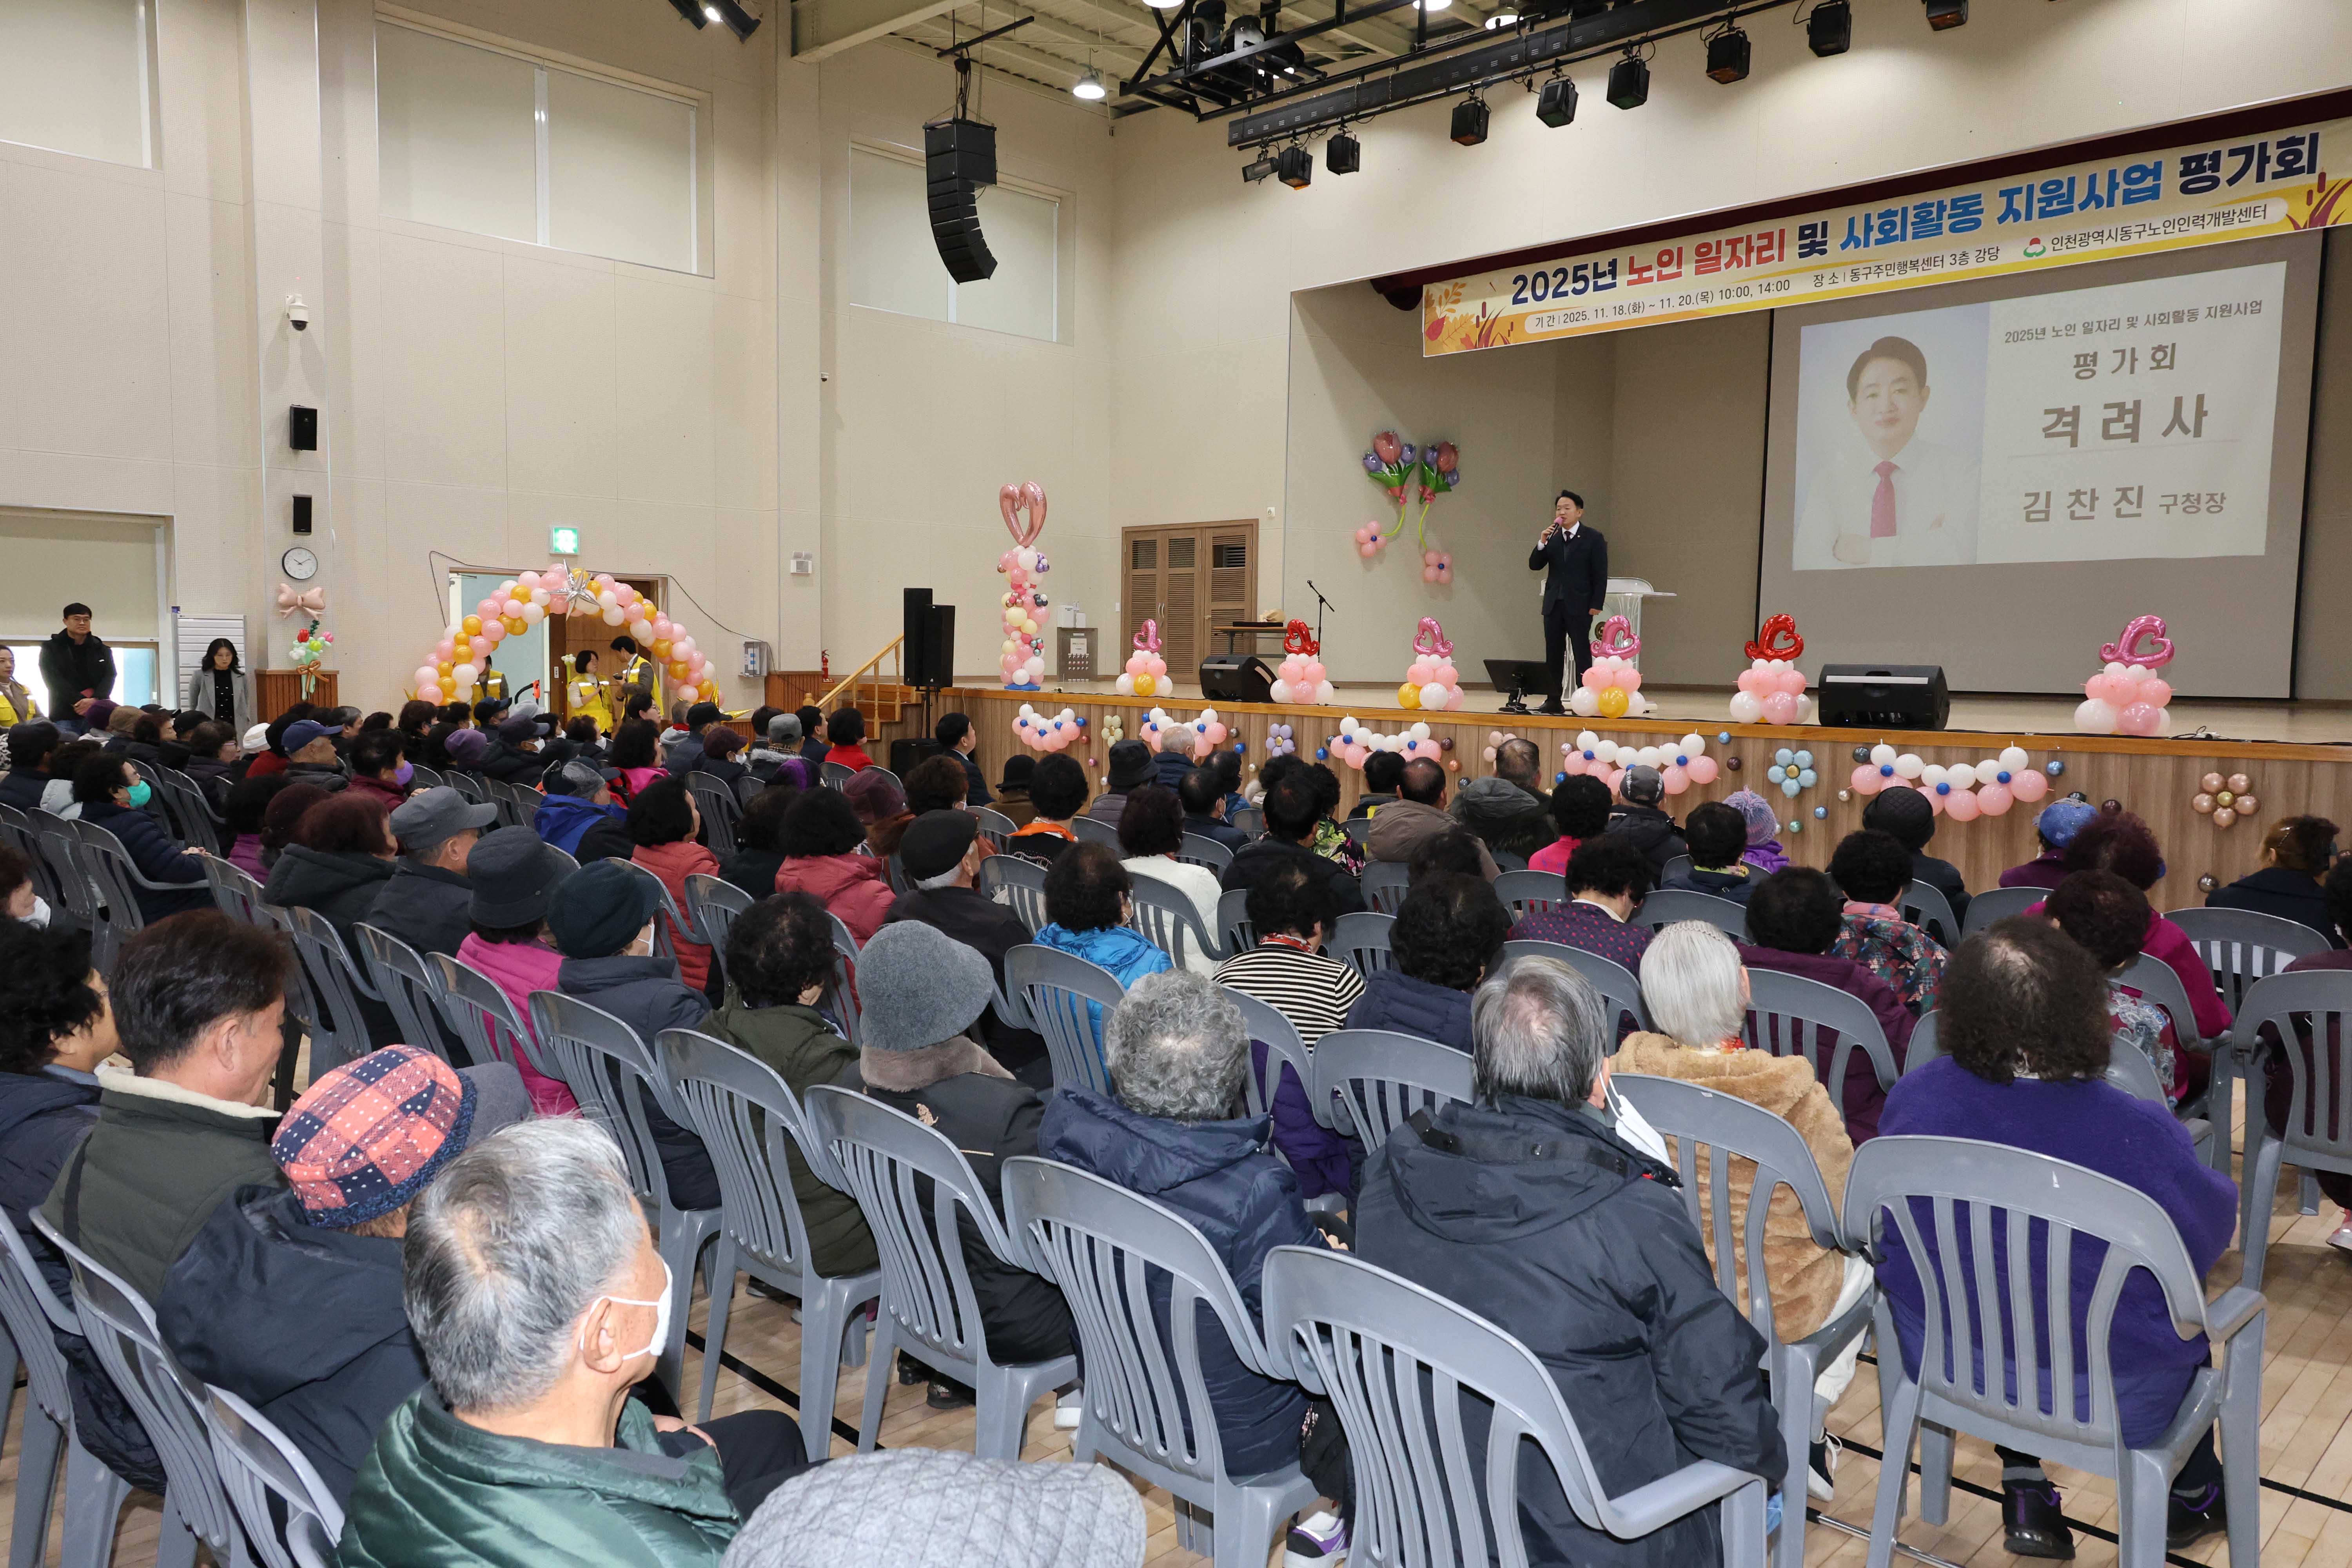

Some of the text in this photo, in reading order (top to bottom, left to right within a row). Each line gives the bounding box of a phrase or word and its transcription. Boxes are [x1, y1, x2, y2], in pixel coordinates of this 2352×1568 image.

[1511, 132, 2320, 306] 2025년 노인 일자리 및 사회활동 지원사업 평가회
[2051, 203, 2267, 251] 인천광역시동구노인인력개발센터
[1850, 254, 1944, 282] 동구주민행복센터
[1949, 251, 1970, 266] 3층
[1975, 246, 2000, 263] 강당
[1563, 310, 1590, 323] 2025.
[1594, 308, 1608, 319] 11.
[1613, 301, 1645, 316] 18.(화)
[1660, 298, 1674, 309] 11.
[1679, 290, 1714, 306] 20.(목)
[1719, 285, 1753, 300] 10:00,
[1758, 279, 1790, 294] 14:00
[2005, 327, 2046, 343] 2025년
[2051, 323, 2076, 338] 노인
[2082, 318, 2120, 335] 일자리
[2127, 316, 2138, 329] 및
[2205, 299, 2262, 319] 지원사업
[2159, 492, 2227, 514] 구청장
